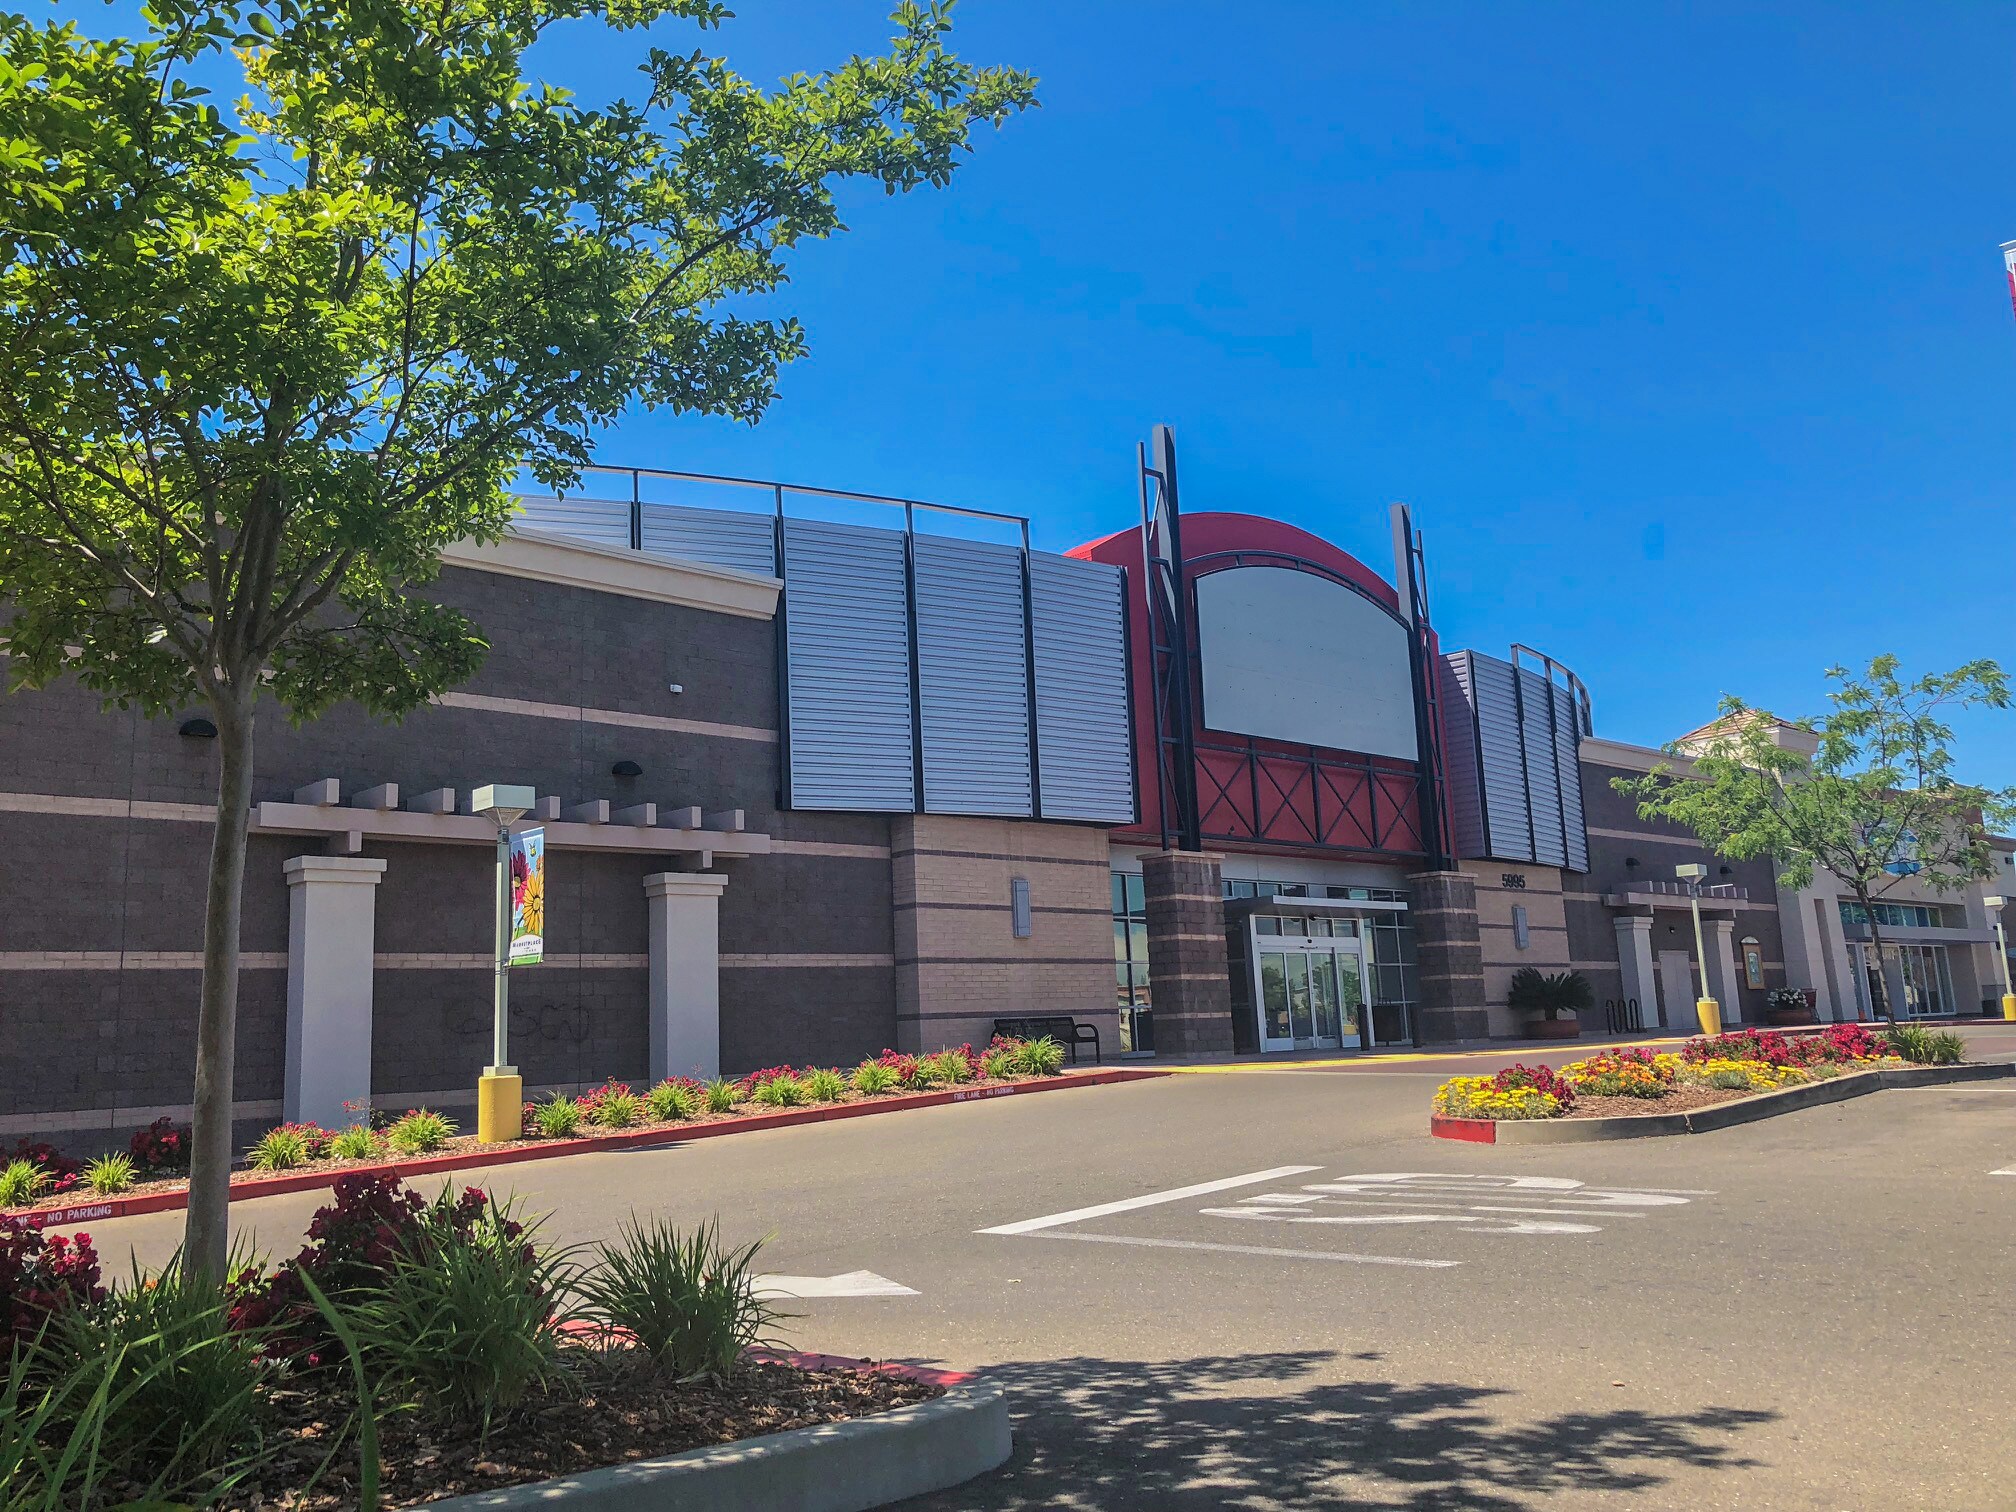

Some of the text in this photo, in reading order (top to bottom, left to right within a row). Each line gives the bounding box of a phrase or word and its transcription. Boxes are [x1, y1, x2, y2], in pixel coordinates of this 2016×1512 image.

[1502, 873, 1526, 889] 5995
[954, 1092, 965, 1100] FIRE
[967, 1090, 981, 1099] LANE
[986, 1088, 994, 1096] NO
[994, 1086, 1014, 1095] PARKING
[1199, 1173, 1719, 1234] STOP
[47, 1212, 63, 1223] NO
[67, 1205, 112, 1220] PARKING
